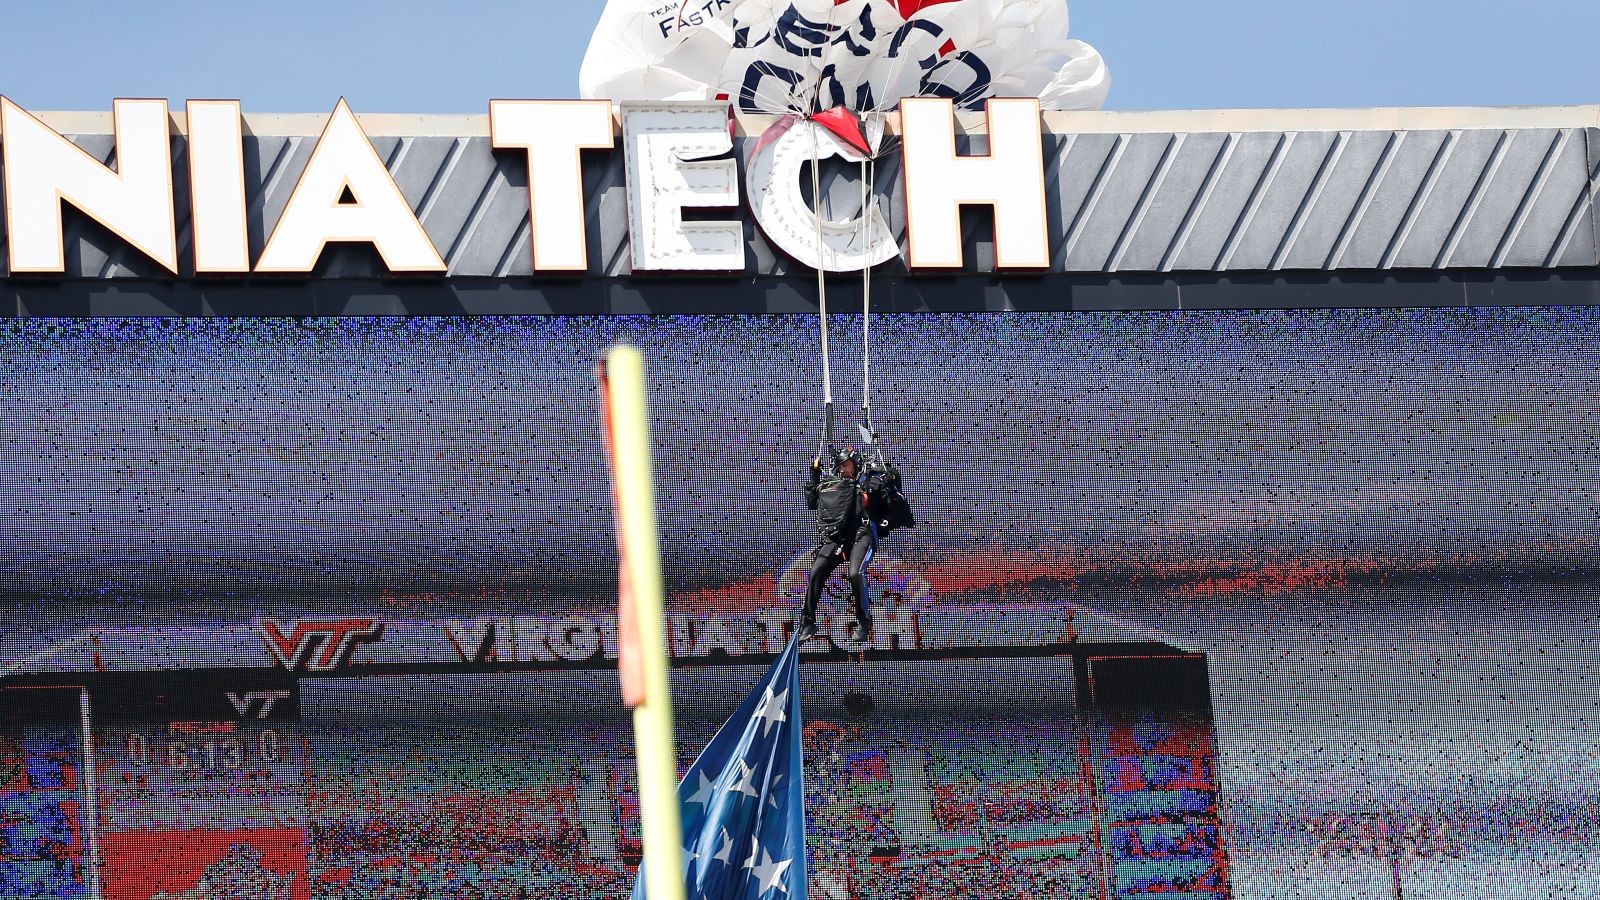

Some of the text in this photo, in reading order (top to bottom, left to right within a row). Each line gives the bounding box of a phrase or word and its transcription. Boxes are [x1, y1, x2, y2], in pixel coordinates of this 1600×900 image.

[648, 2, 679, 18] TEAM
[489, 96, 1050, 276] TECH
[257, 616, 381, 671] VT
[446, 613, 746, 663] VIRGIIA
[225, 690, 290, 718] VT
